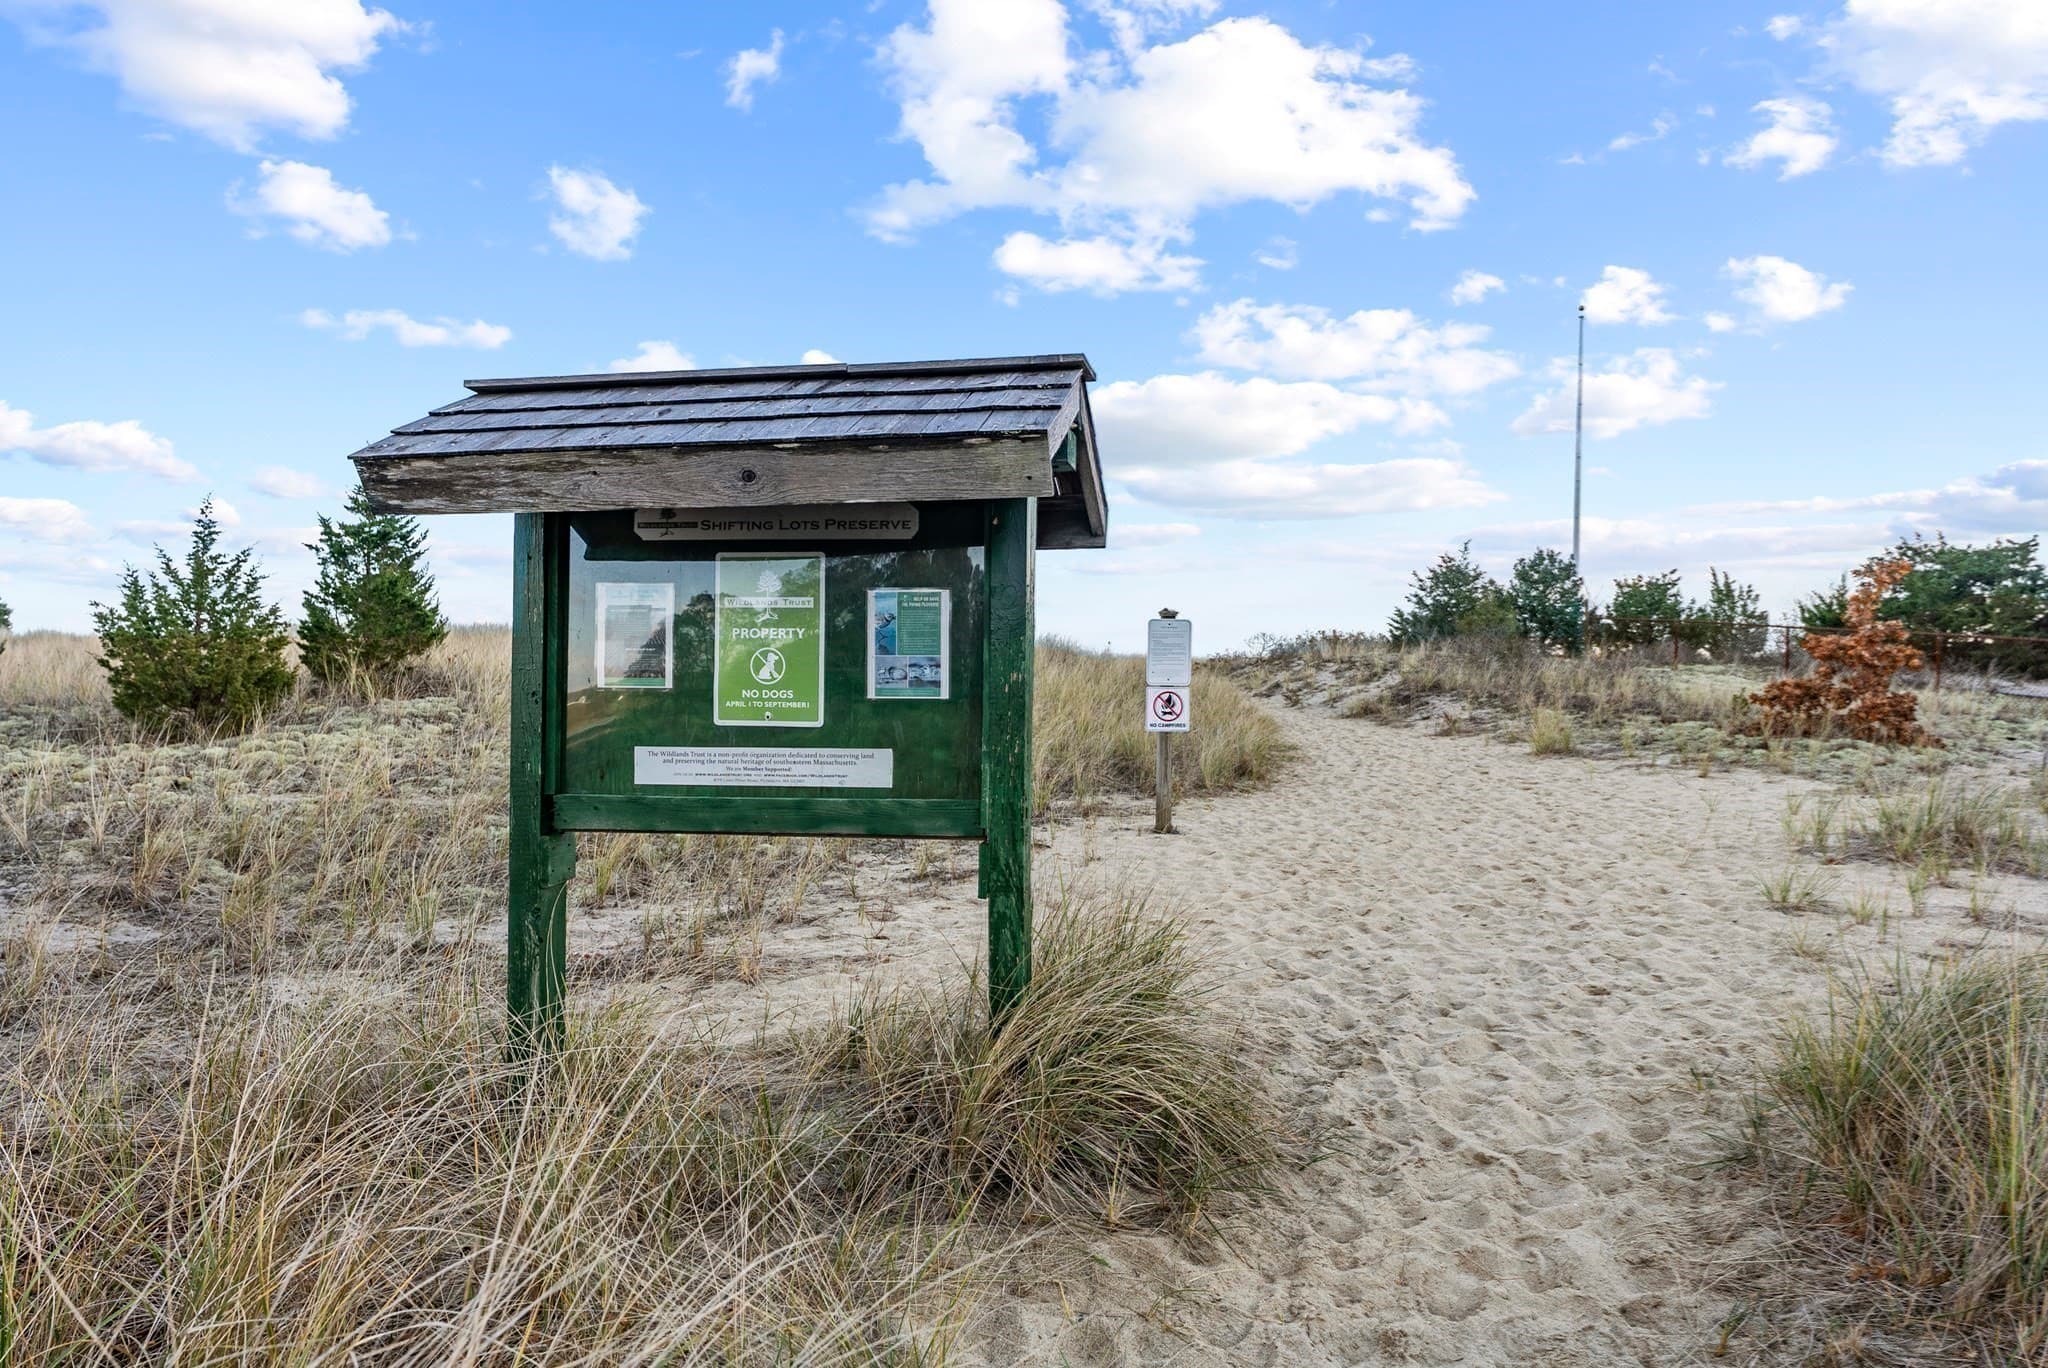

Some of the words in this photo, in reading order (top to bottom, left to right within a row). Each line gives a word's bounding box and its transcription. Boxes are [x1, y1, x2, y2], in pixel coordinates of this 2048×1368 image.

[700, 520, 774, 531] SHIFTING
[780, 520, 820, 531] LOTS
[825, 519, 912, 531] PRESERVE
[732, 627, 805, 639] PROPERTY
[741, 689, 759, 698] NO
[762, 690, 794, 698] DOGS
